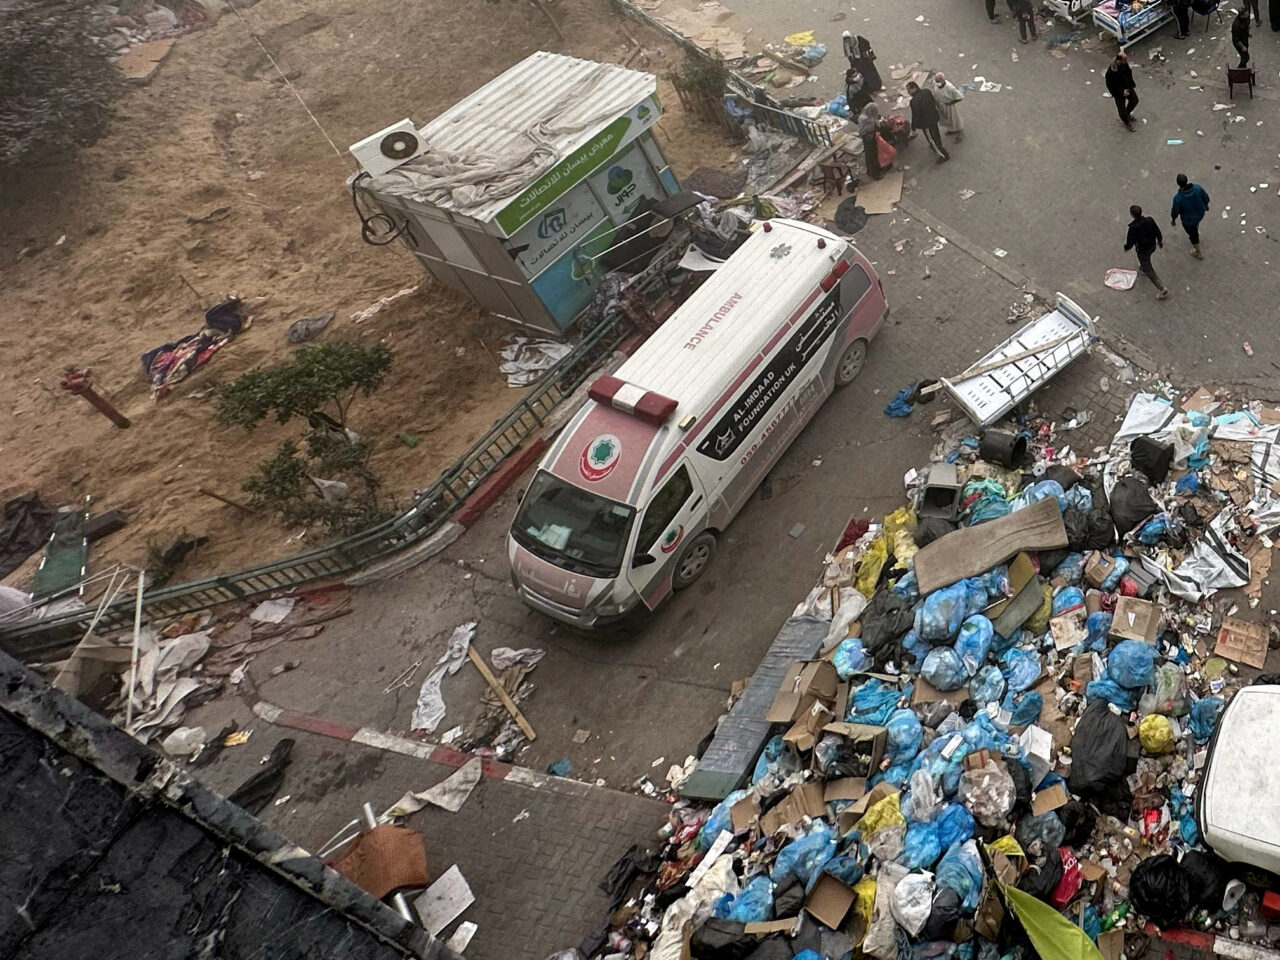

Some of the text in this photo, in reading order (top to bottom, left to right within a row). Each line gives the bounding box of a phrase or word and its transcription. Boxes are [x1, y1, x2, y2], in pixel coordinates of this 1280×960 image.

[519, 134, 614, 208] معرض بيسان للاتصالات
[614, 182, 637, 207] جوال
[530, 231, 568, 266] للاتصالات
[570, 211, 593, 235] بيسان
[683, 292, 743, 351] AMBULANCE
[795, 301, 835, 352] مستشفى
[801, 310, 839, 362] الخير
[738, 362, 797, 432] FOUNDATION UK
